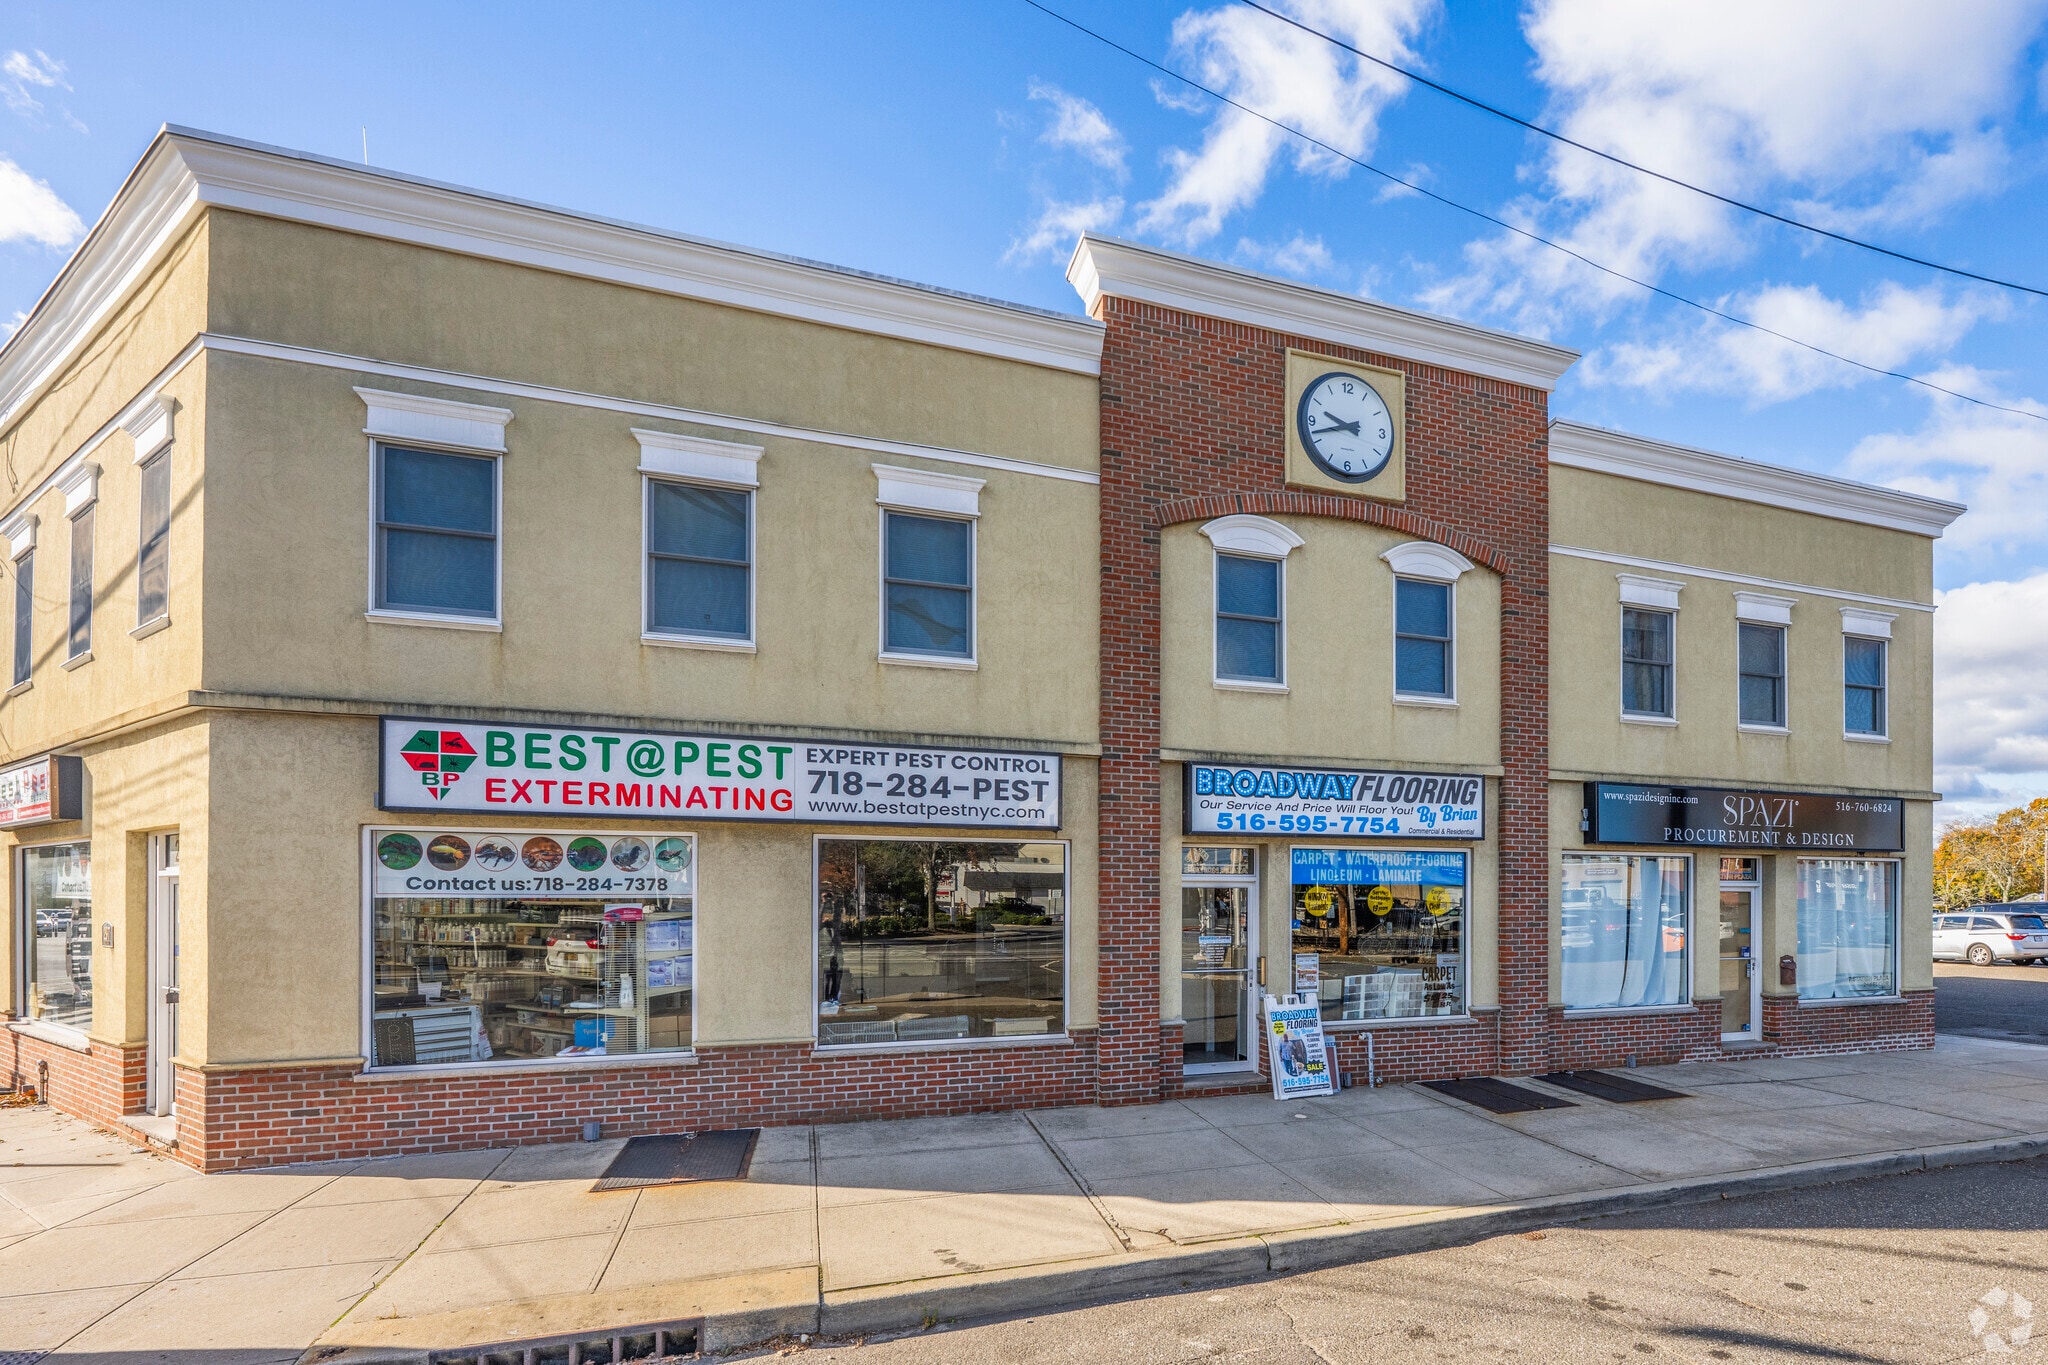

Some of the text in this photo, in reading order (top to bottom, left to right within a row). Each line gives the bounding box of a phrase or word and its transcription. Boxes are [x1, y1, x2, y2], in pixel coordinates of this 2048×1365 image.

[1341, 382, 1354, 394] 12
[1308, 415, 1316, 426] 9
[1378, 428, 1386, 439] 3
[1343, 460, 1352, 472] 6
[806, 747, 1050, 774] EXPERT PEST CONTROL
[807, 769, 1049, 802] 718-284-PEST
[1196, 768, 1479, 806] BROADWAY FLOORING
[485, 778, 793, 812] EXTERMINATING
[1604, 791, 1699, 805] www.spazidesigninc.com
[808, 799, 1045, 821] www.bestatpestnyc.com
[1200, 800, 1414, 815] Our Service And Price Will Floor You!
[1723, 795, 1794, 828] SPAZI
[1835, 801, 1892, 813] 516-760-6824
[1216, 812, 1400, 834] 516-595-7754
[1416, 805, 1478, 828] By Brian
[1408, 827, 1440, 835] Commercial
[1664, 827, 1854, 846] PROCUREMENT & DESIGN
[1293, 851, 1463, 868] CARPET WATERPROOF FLOORING
[1310, 868, 1422, 882] LINOLEUM LAMINATE
[405, 876, 497, 891] Contact
[1421, 965, 1458, 981] CARPET
[1270, 1008, 1318, 1021] BROADWAY
[1286, 1019, 1318, 1029] FLOORING
[1306, 1063, 1323, 1071] SALE
